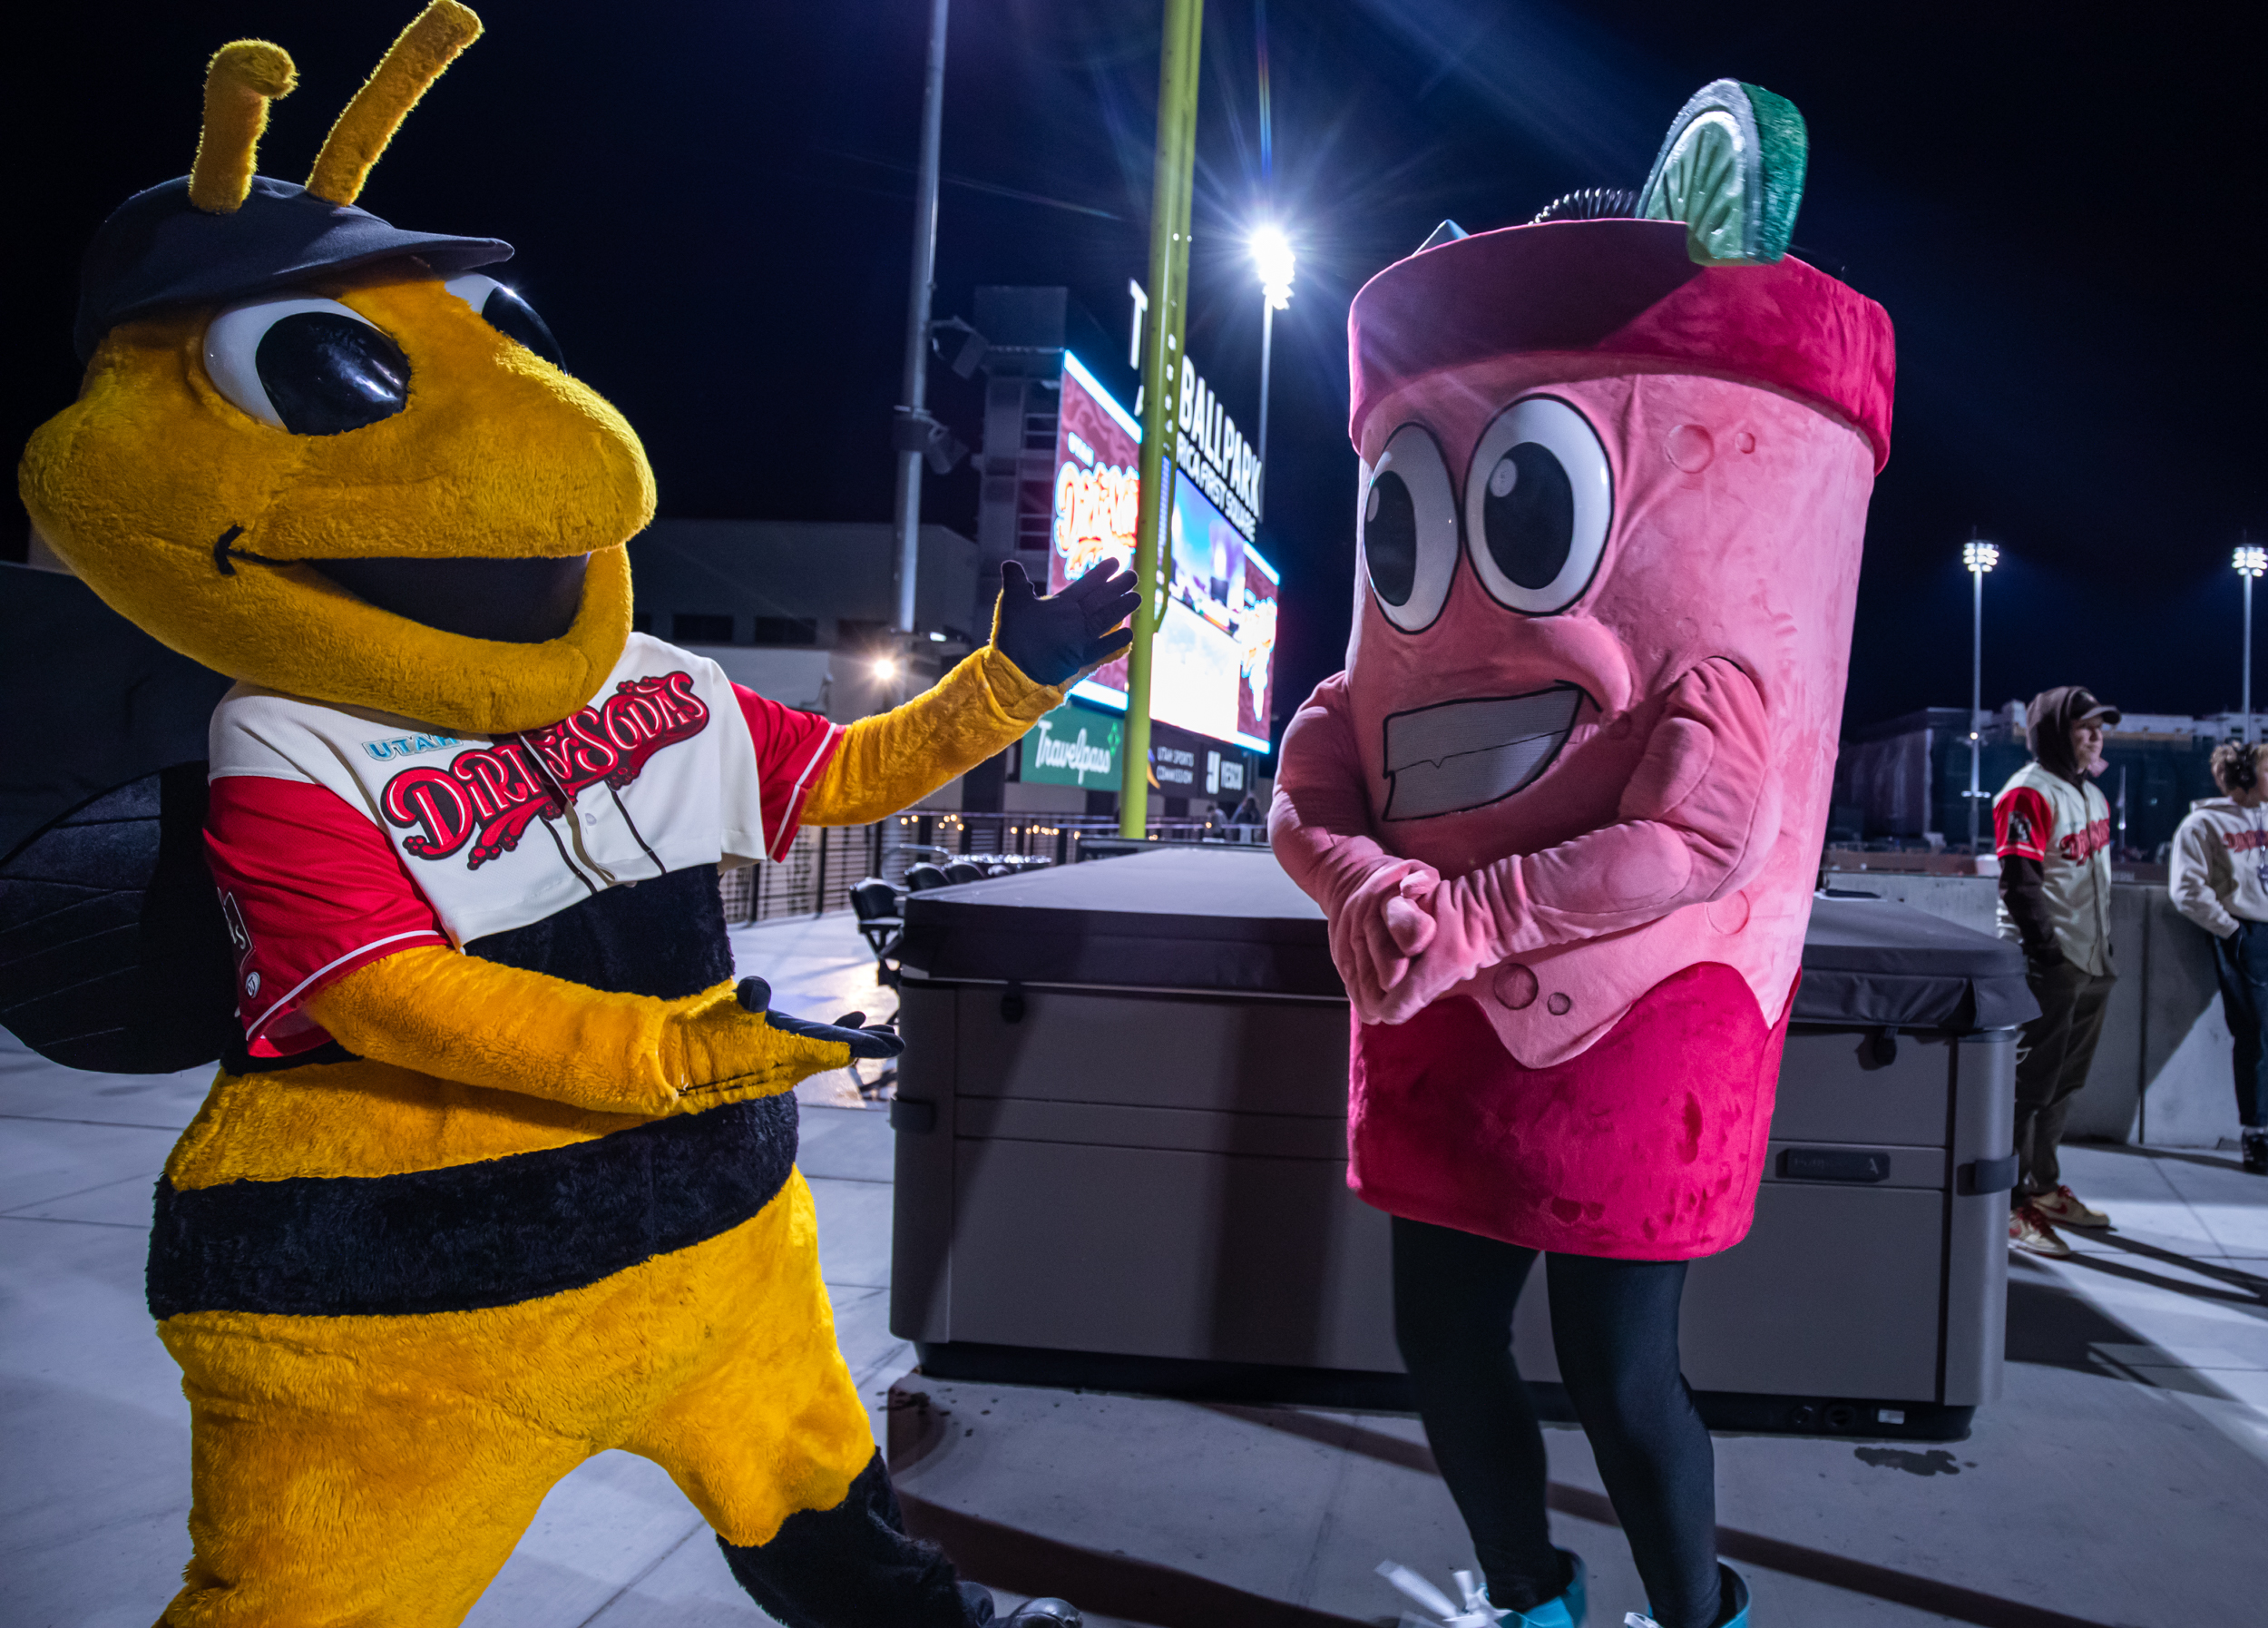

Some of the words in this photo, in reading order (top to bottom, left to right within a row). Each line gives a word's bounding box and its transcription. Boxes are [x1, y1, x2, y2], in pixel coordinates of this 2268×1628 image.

[1176, 431, 1202, 489] RICA
[1178, 355, 1262, 518] BALLPARK
[367, 732, 459, 759] UTAH
[564, 675, 707, 774] SODAS
[1035, 720, 1111, 786] Travelpass
